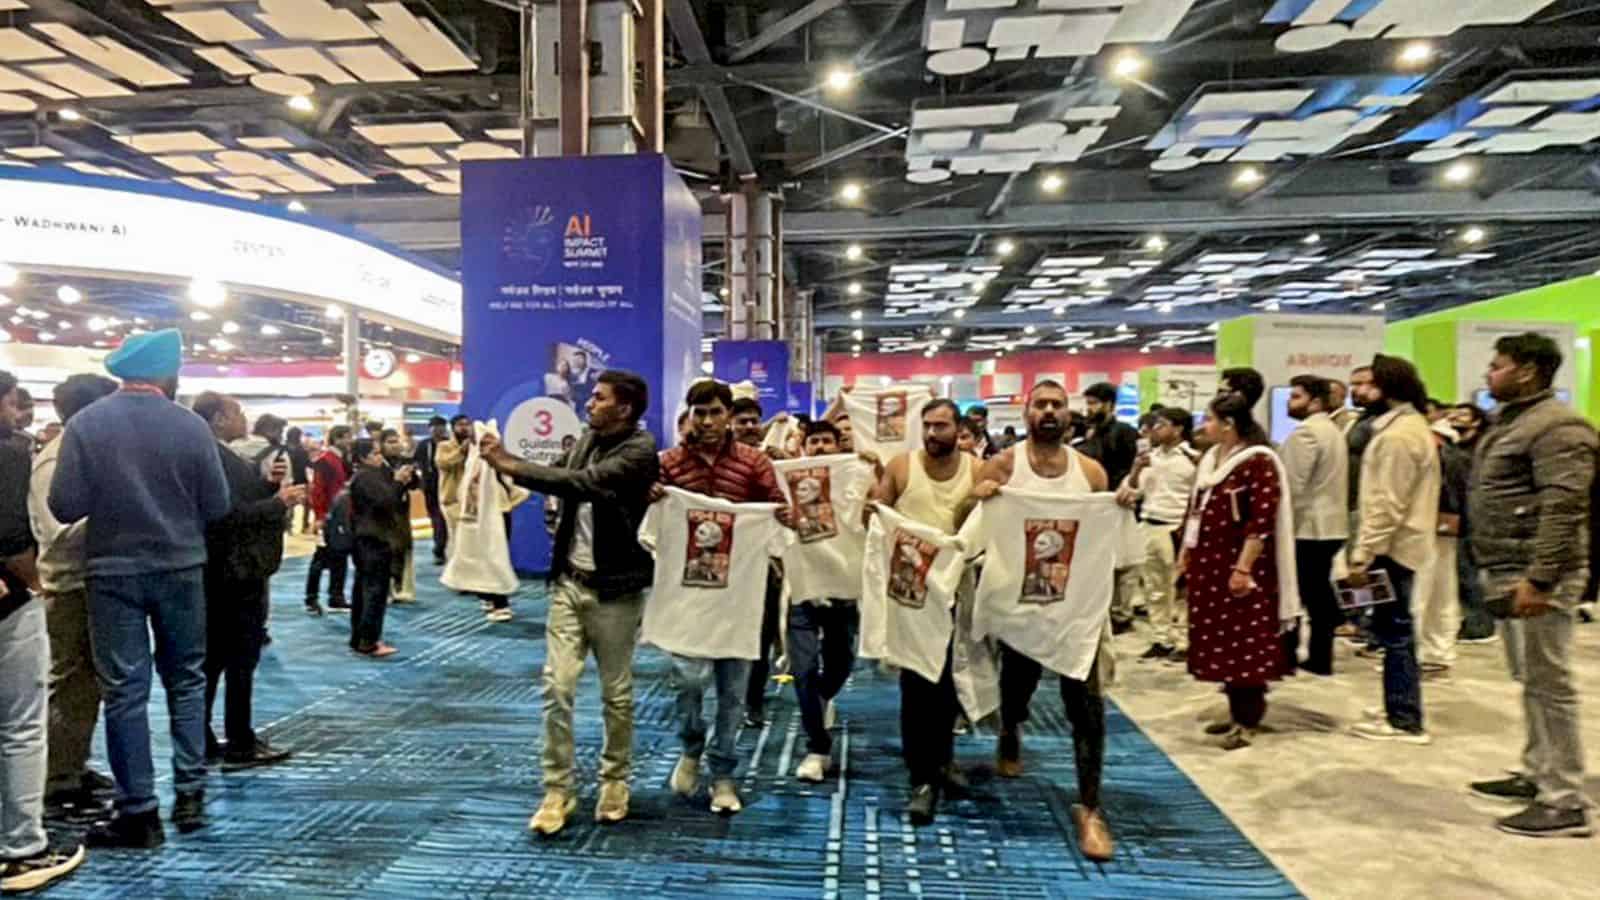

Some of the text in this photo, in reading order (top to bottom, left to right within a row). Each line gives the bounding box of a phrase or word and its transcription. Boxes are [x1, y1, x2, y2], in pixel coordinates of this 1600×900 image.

[564, 213, 591, 237] AI
[564, 237, 605, 248] IMPACT
[564, 247, 608, 258] SUMMIT
[534, 410, 553, 437] 3
[518, 438, 561, 450] Guidin
